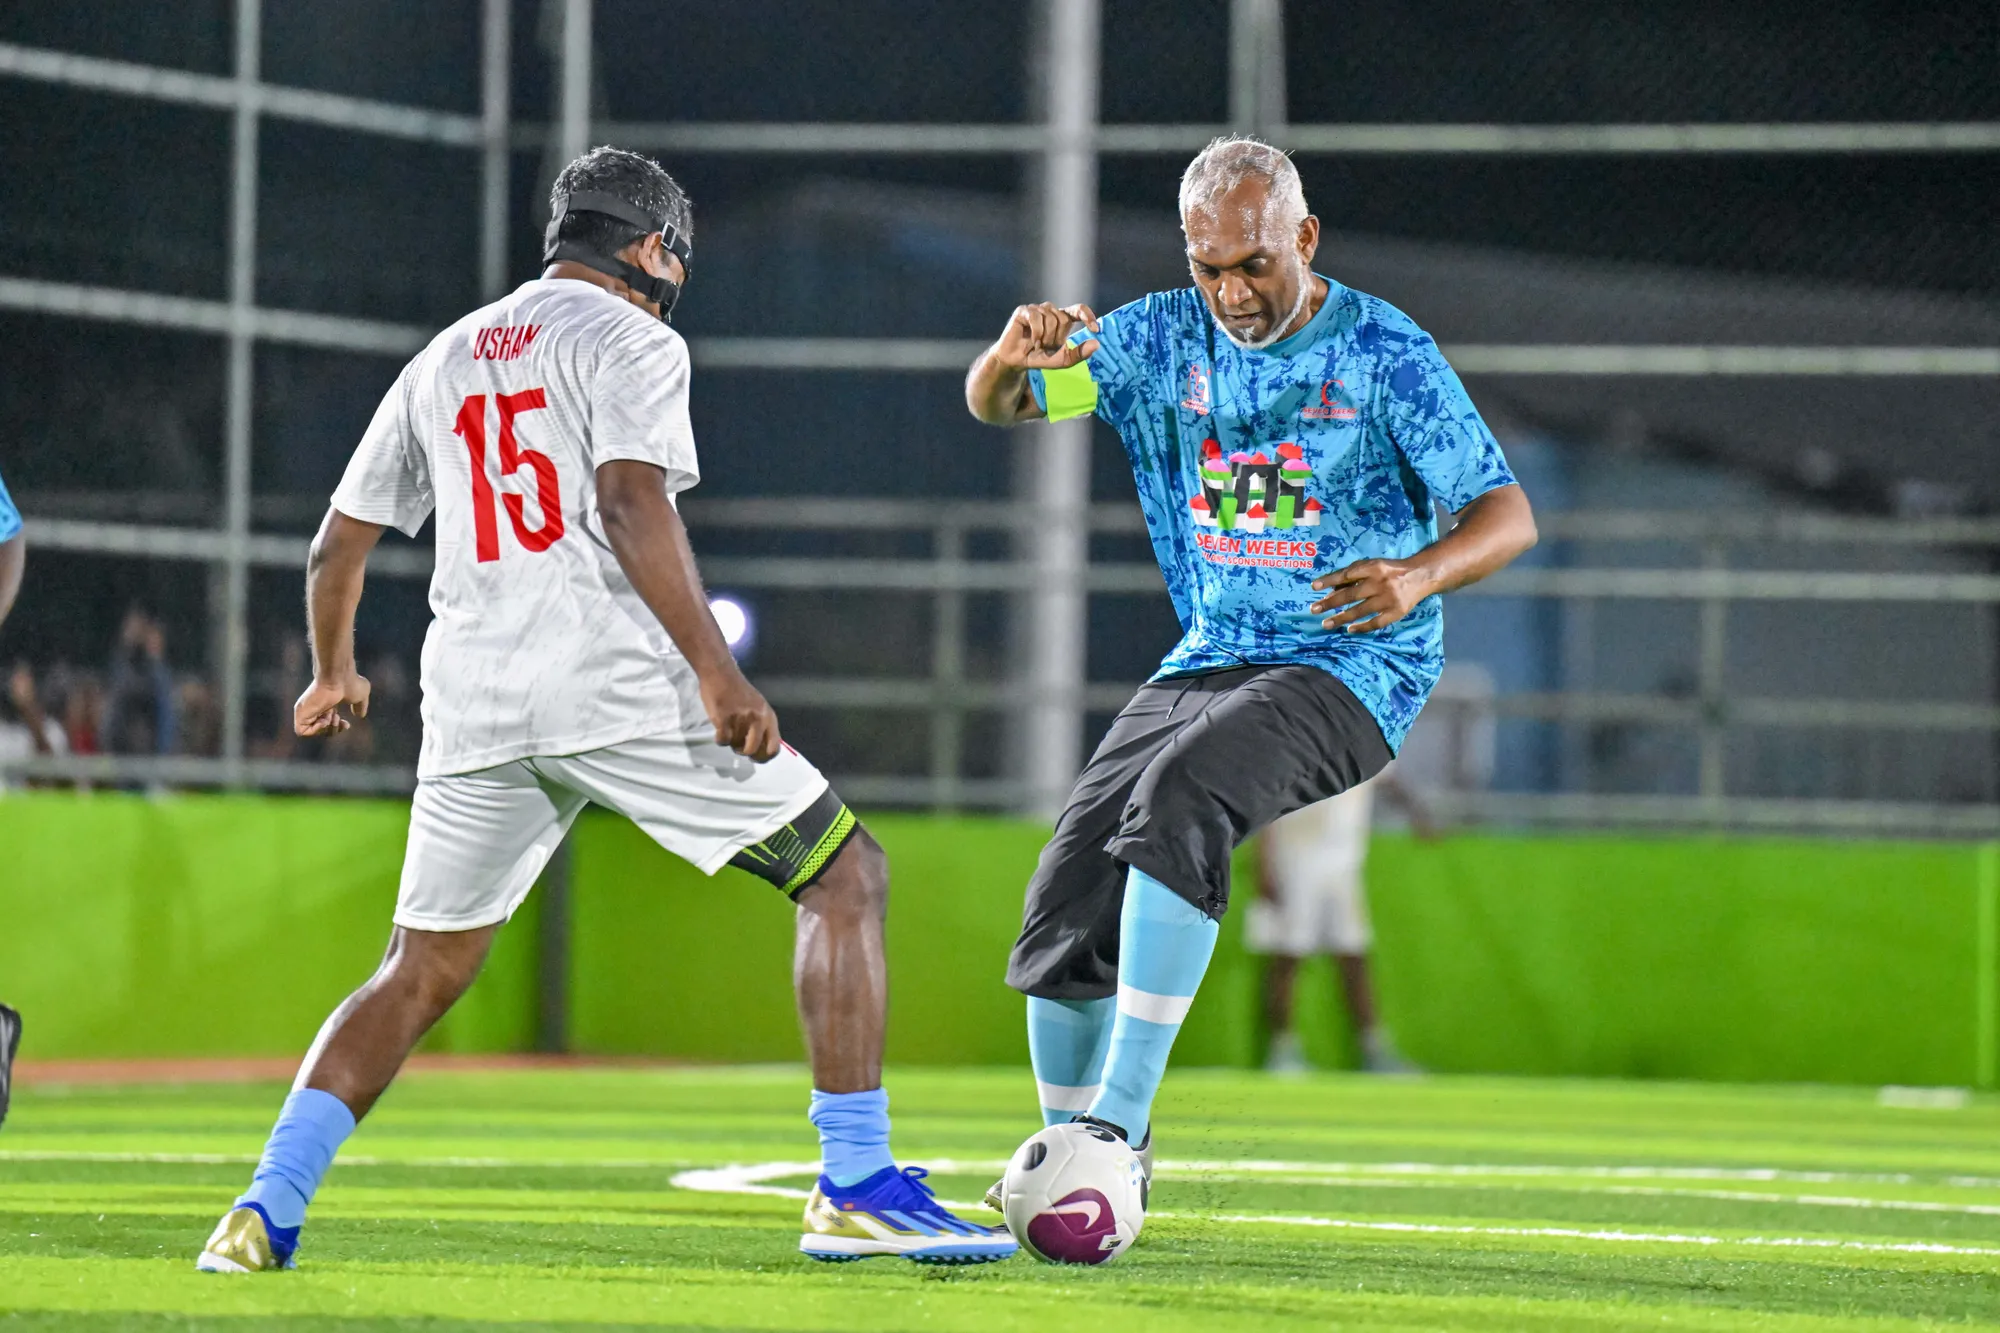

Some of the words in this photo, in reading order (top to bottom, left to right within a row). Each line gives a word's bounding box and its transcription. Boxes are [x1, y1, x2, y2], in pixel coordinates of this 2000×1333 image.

[473, 324, 542, 361] USHAM
[453, 387, 565, 563] 15
[1196, 532, 1241, 553] SEVEN
[1246, 540, 1317, 557] WEEKS
